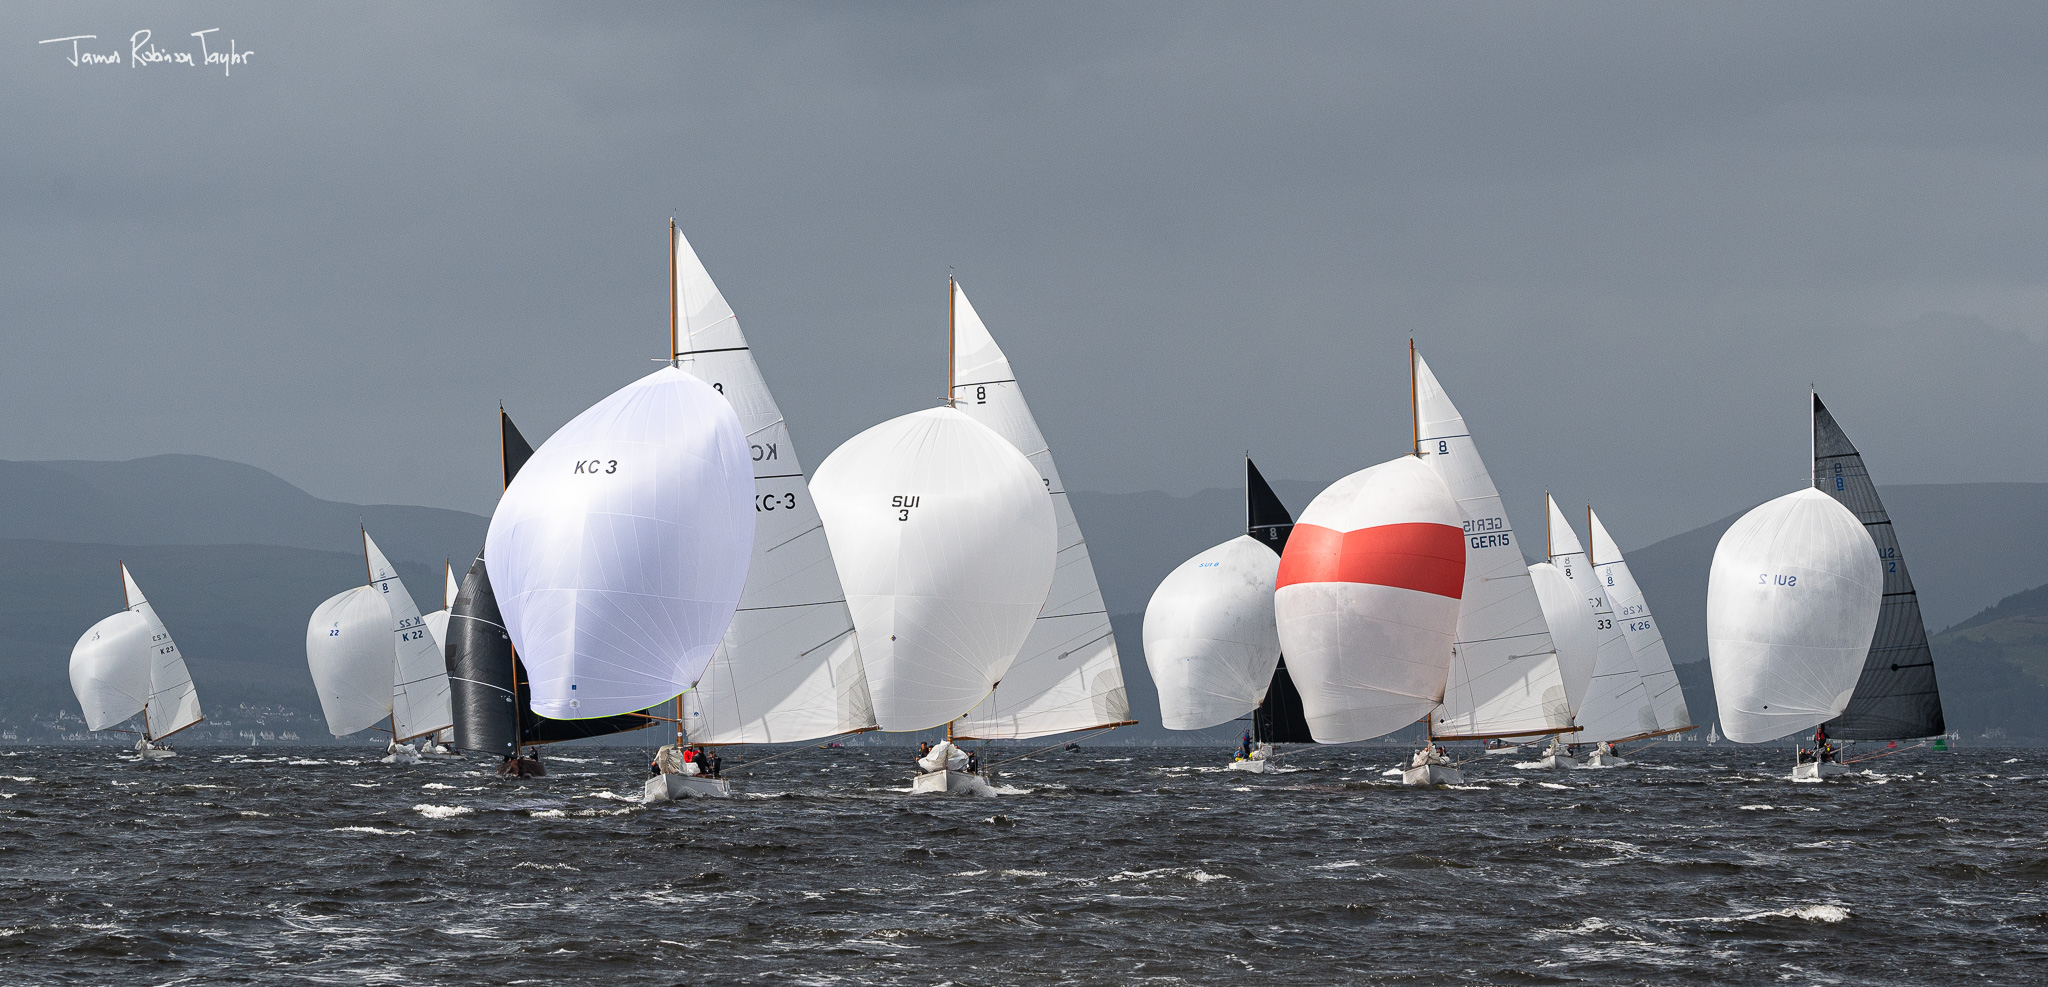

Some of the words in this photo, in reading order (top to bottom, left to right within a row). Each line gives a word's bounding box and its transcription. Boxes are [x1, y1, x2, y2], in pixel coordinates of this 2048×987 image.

[976, 386, 986, 400] 8
[1438, 440, 1447, 452] 8
[573, 459, 601, 475] KC
[605, 459, 618, 475] 3
[1836, 477, 1844, 488] 8
[891, 494, 920, 508] SUI
[898, 508, 909, 522] 3
[1269, 527, 1277, 537] 8
[1470, 534, 1510, 549] GER15
[1565, 568, 1572, 577] 8
[1607, 576, 1614, 585] 8
[382, 582, 388, 591] 8
[1597, 619, 1612, 630] 33
[1630, 623, 1637, 632] K
[1639, 621, 1651, 630] 26
[329, 629, 340, 637] 22
[402, 633, 409, 642] K
[412, 630, 424, 640] 22
